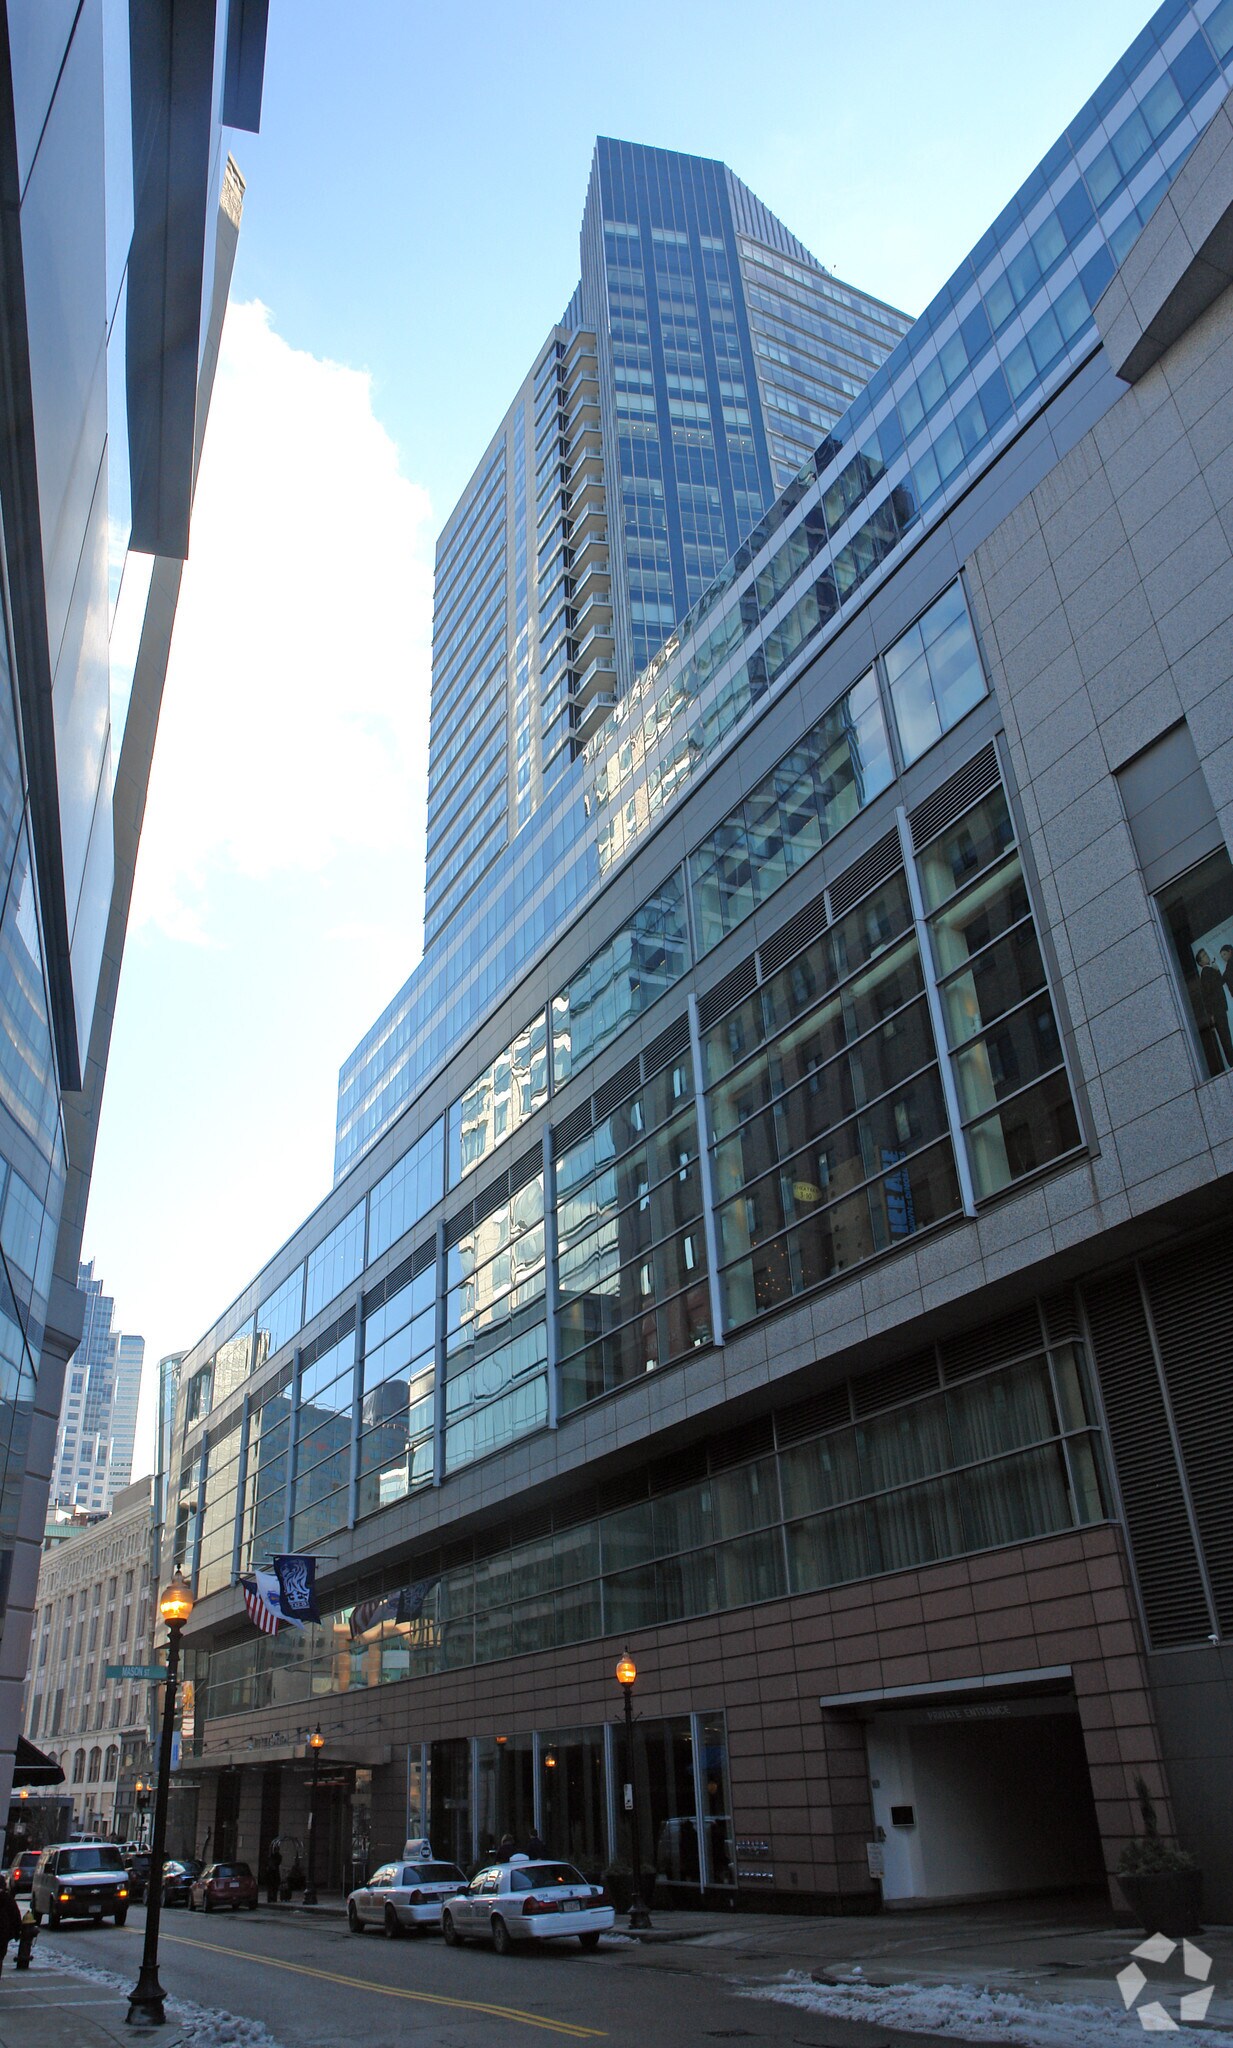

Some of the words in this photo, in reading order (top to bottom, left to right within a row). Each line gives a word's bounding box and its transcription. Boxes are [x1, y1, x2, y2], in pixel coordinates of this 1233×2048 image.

[888, 1194, 908, 1233] ICE
[122, 1666, 143, 1677] MASON
[144, 1668, 150, 1677] ST
[927, 1710, 962, 1720] PRIVATE
[963, 1705, 1011, 1718] ENTRANCE
